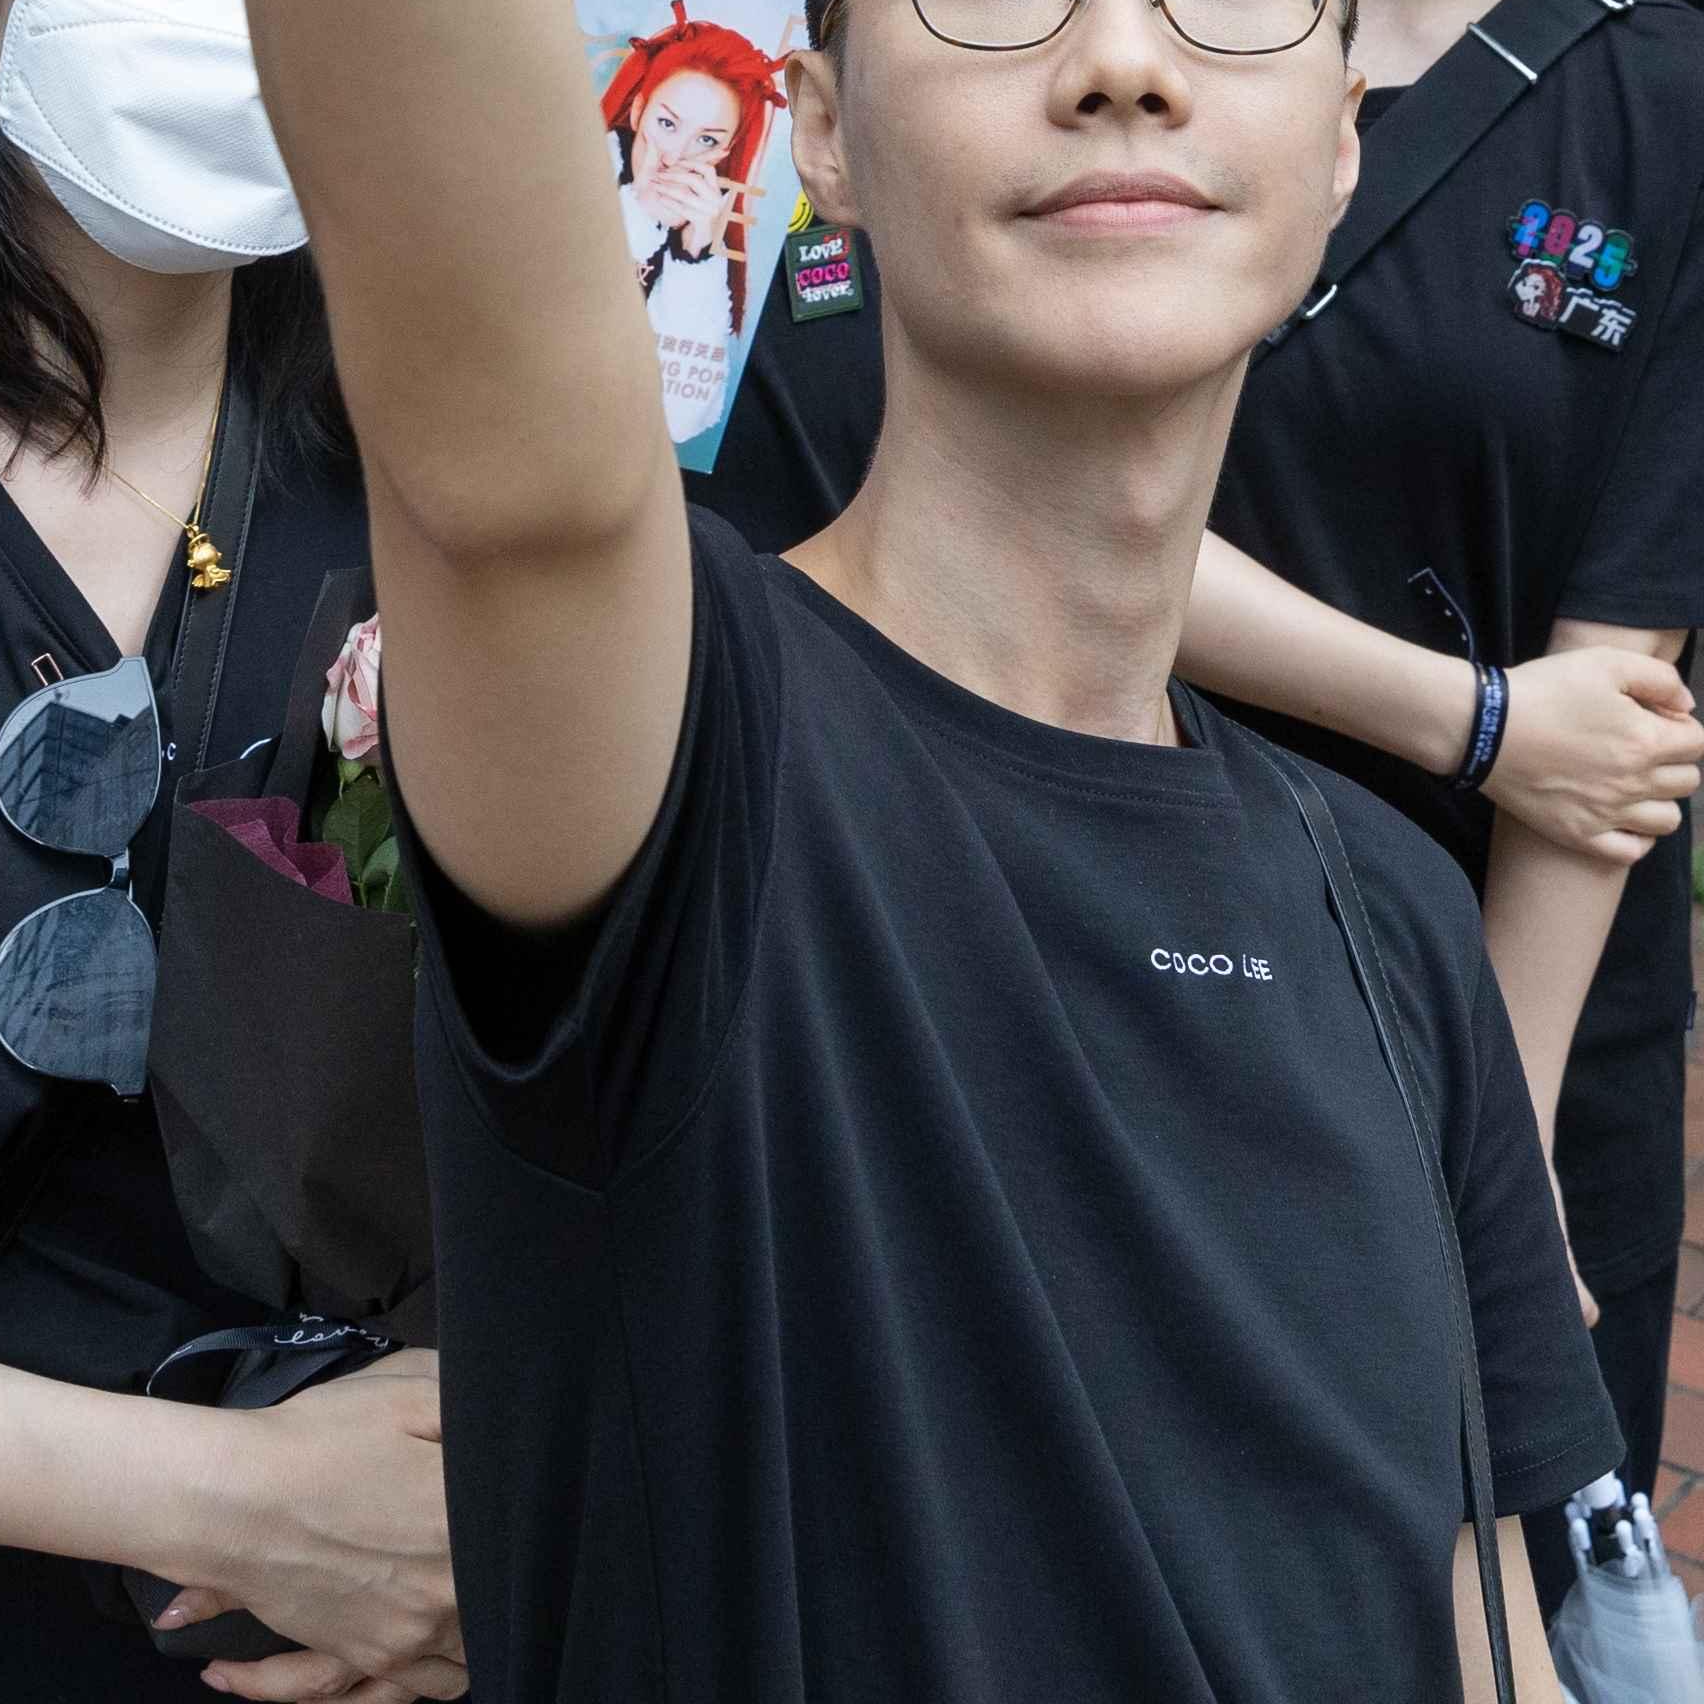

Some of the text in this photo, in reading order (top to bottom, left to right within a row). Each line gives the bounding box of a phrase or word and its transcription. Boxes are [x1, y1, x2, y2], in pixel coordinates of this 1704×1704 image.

[799, 237, 844, 263] LOVE
[797, 262, 851, 287] COCO
[1558, 293, 1635, 346] 广东
[1150, 947, 1273, 981] COCO LEE
